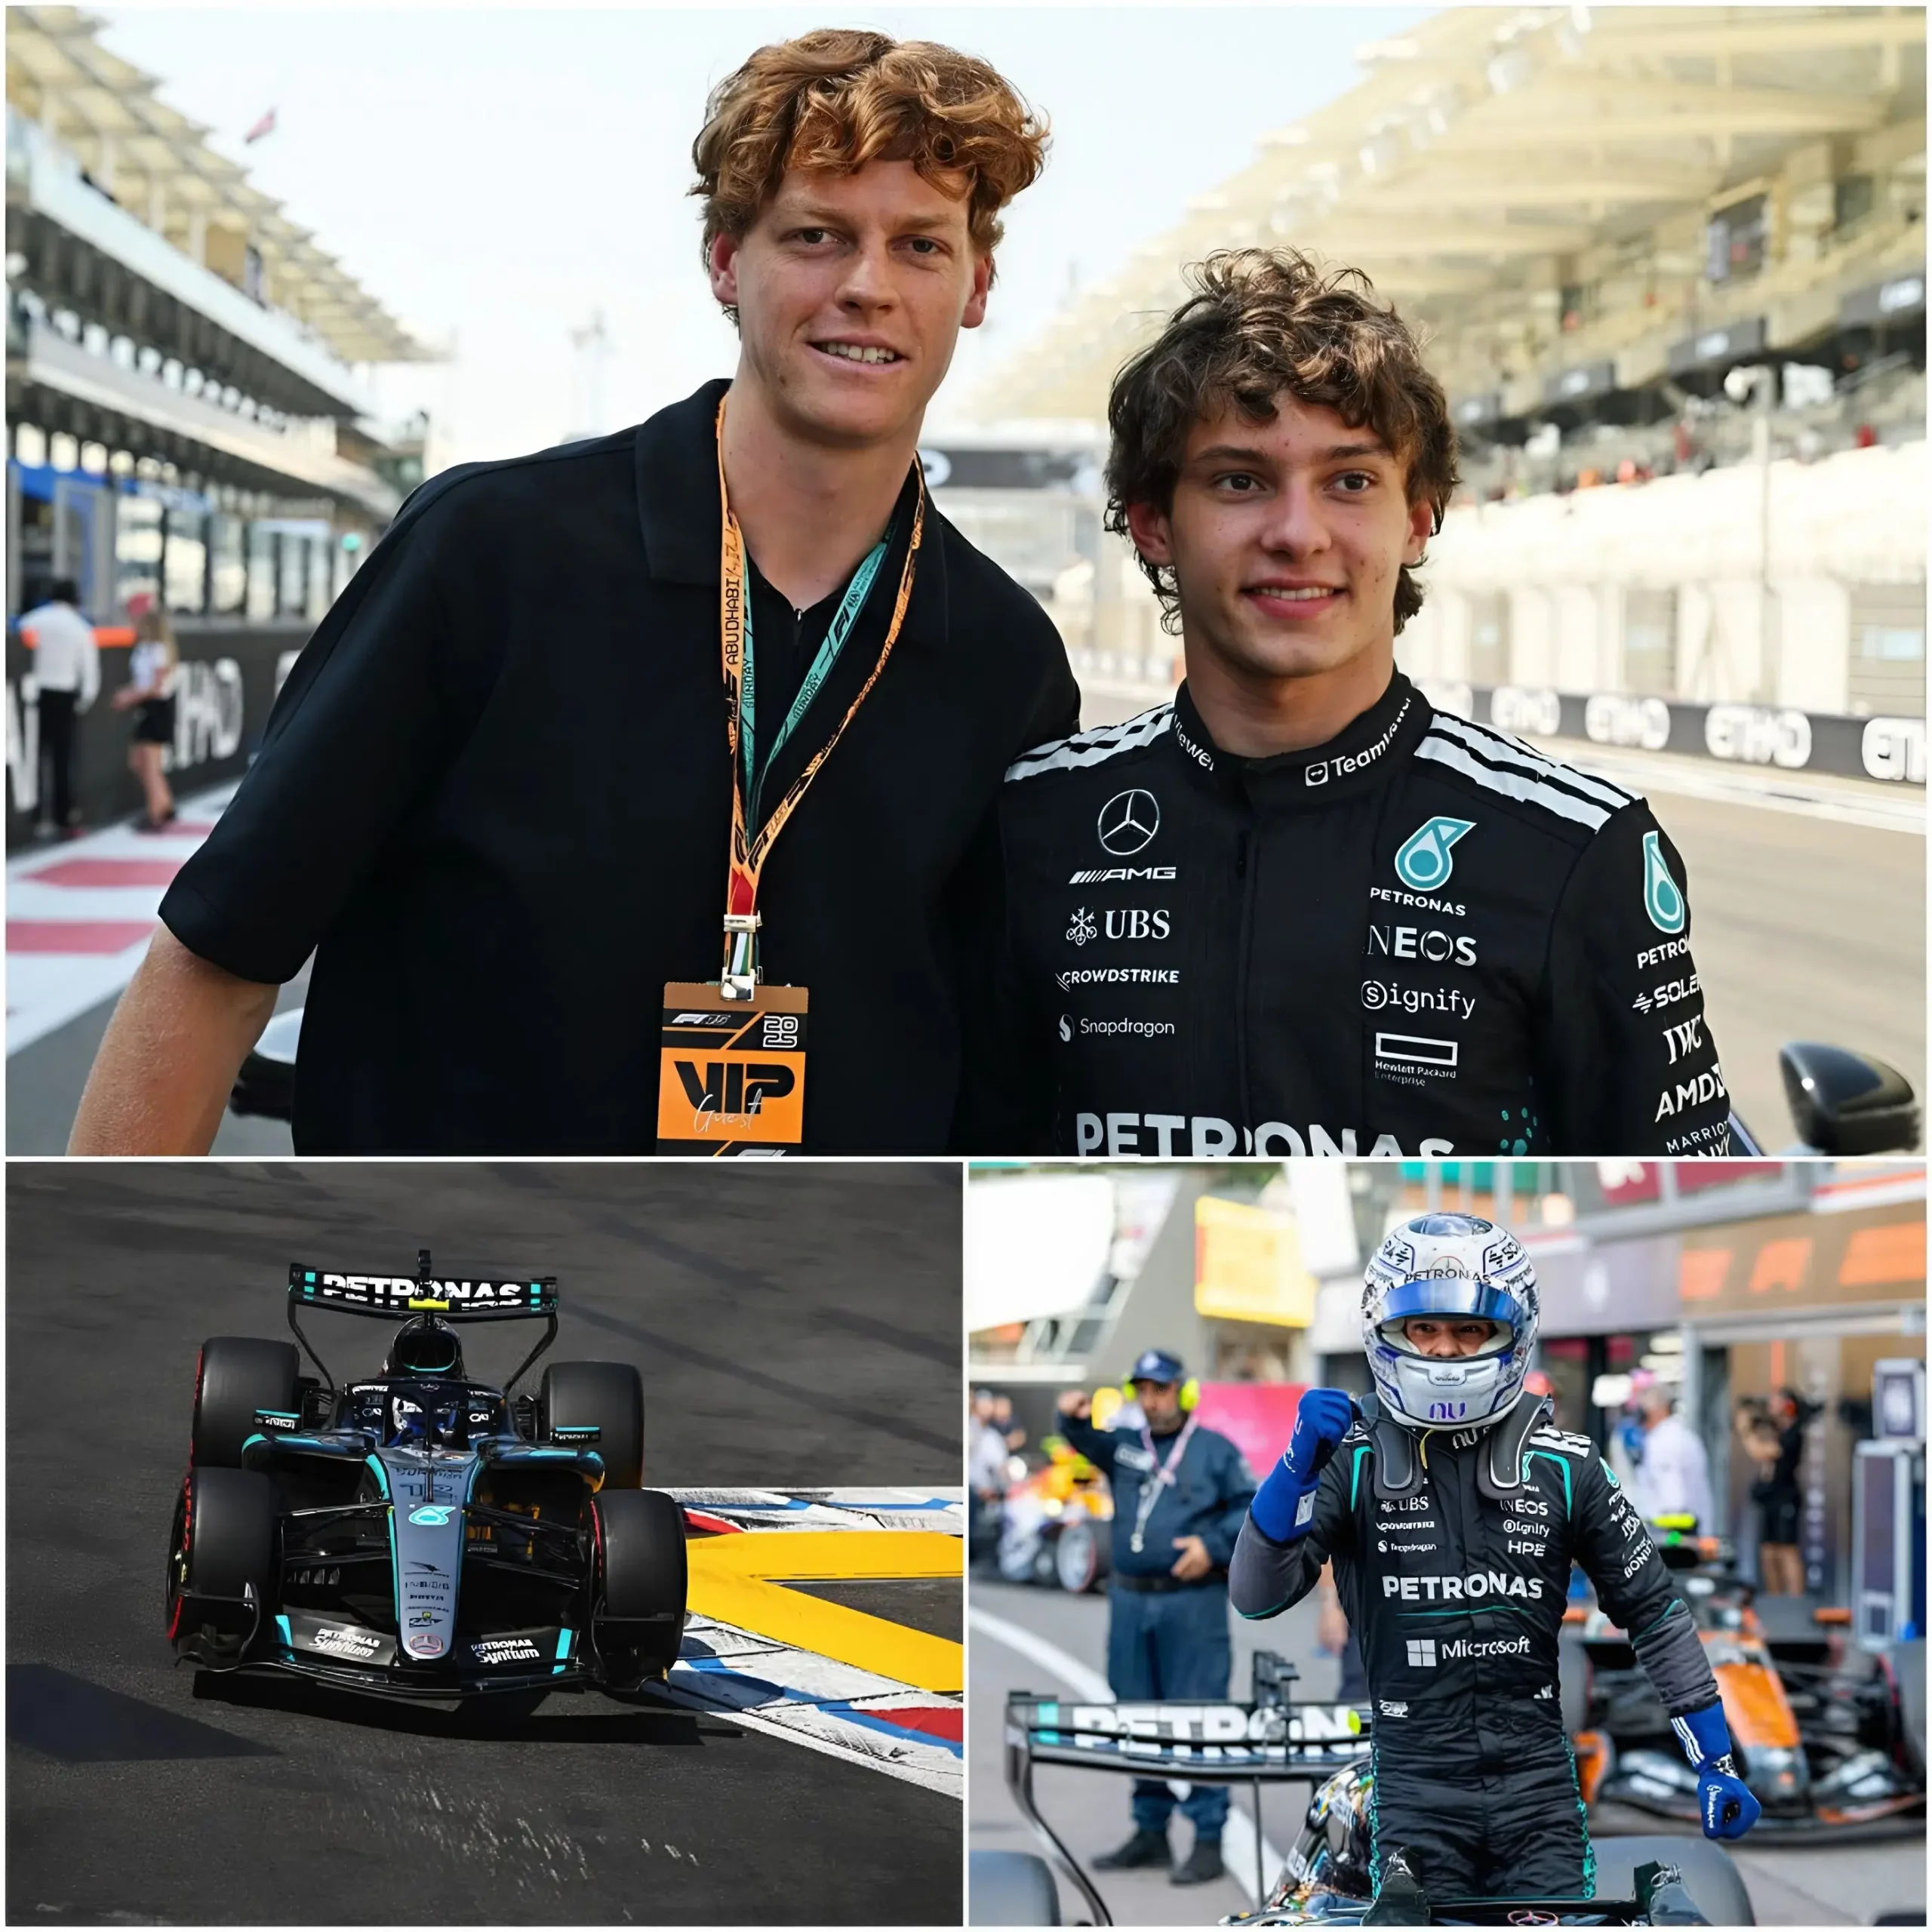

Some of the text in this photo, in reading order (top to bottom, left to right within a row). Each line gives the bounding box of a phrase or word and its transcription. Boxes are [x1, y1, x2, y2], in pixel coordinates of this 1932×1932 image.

[725, 577, 740, 630] DHABI
[725, 632, 740, 665] ABU
[1101, 866, 1177, 882] AMG
[1370, 887, 1466, 917] PETRONAS
[1105, 909, 1171, 940] UBS
[1361, 924, 1478, 967] NEOS
[1637, 935, 1690, 970] PETRO
[1061, 968, 1180, 984] CROWDSTRIKE
[1079, 1017, 1175, 1038] Snapdragon
[1662, 1014, 1703, 1066] IWC
[673, 1060, 795, 1115] VIP
[1654, 1072, 1715, 1124] AMD
[694, 1088, 762, 1133] Guest
[1404, 1268, 1492, 1284] PETRONAS
[1398, 1496, 1429, 1511] UBS
[1507, 1540, 1546, 1557] HPE
[1382, 1570, 1545, 1600] PETRONAS
[1441, 1635, 1531, 1660] Microsoft
[1072, 1706, 1371, 1758] PETRON
